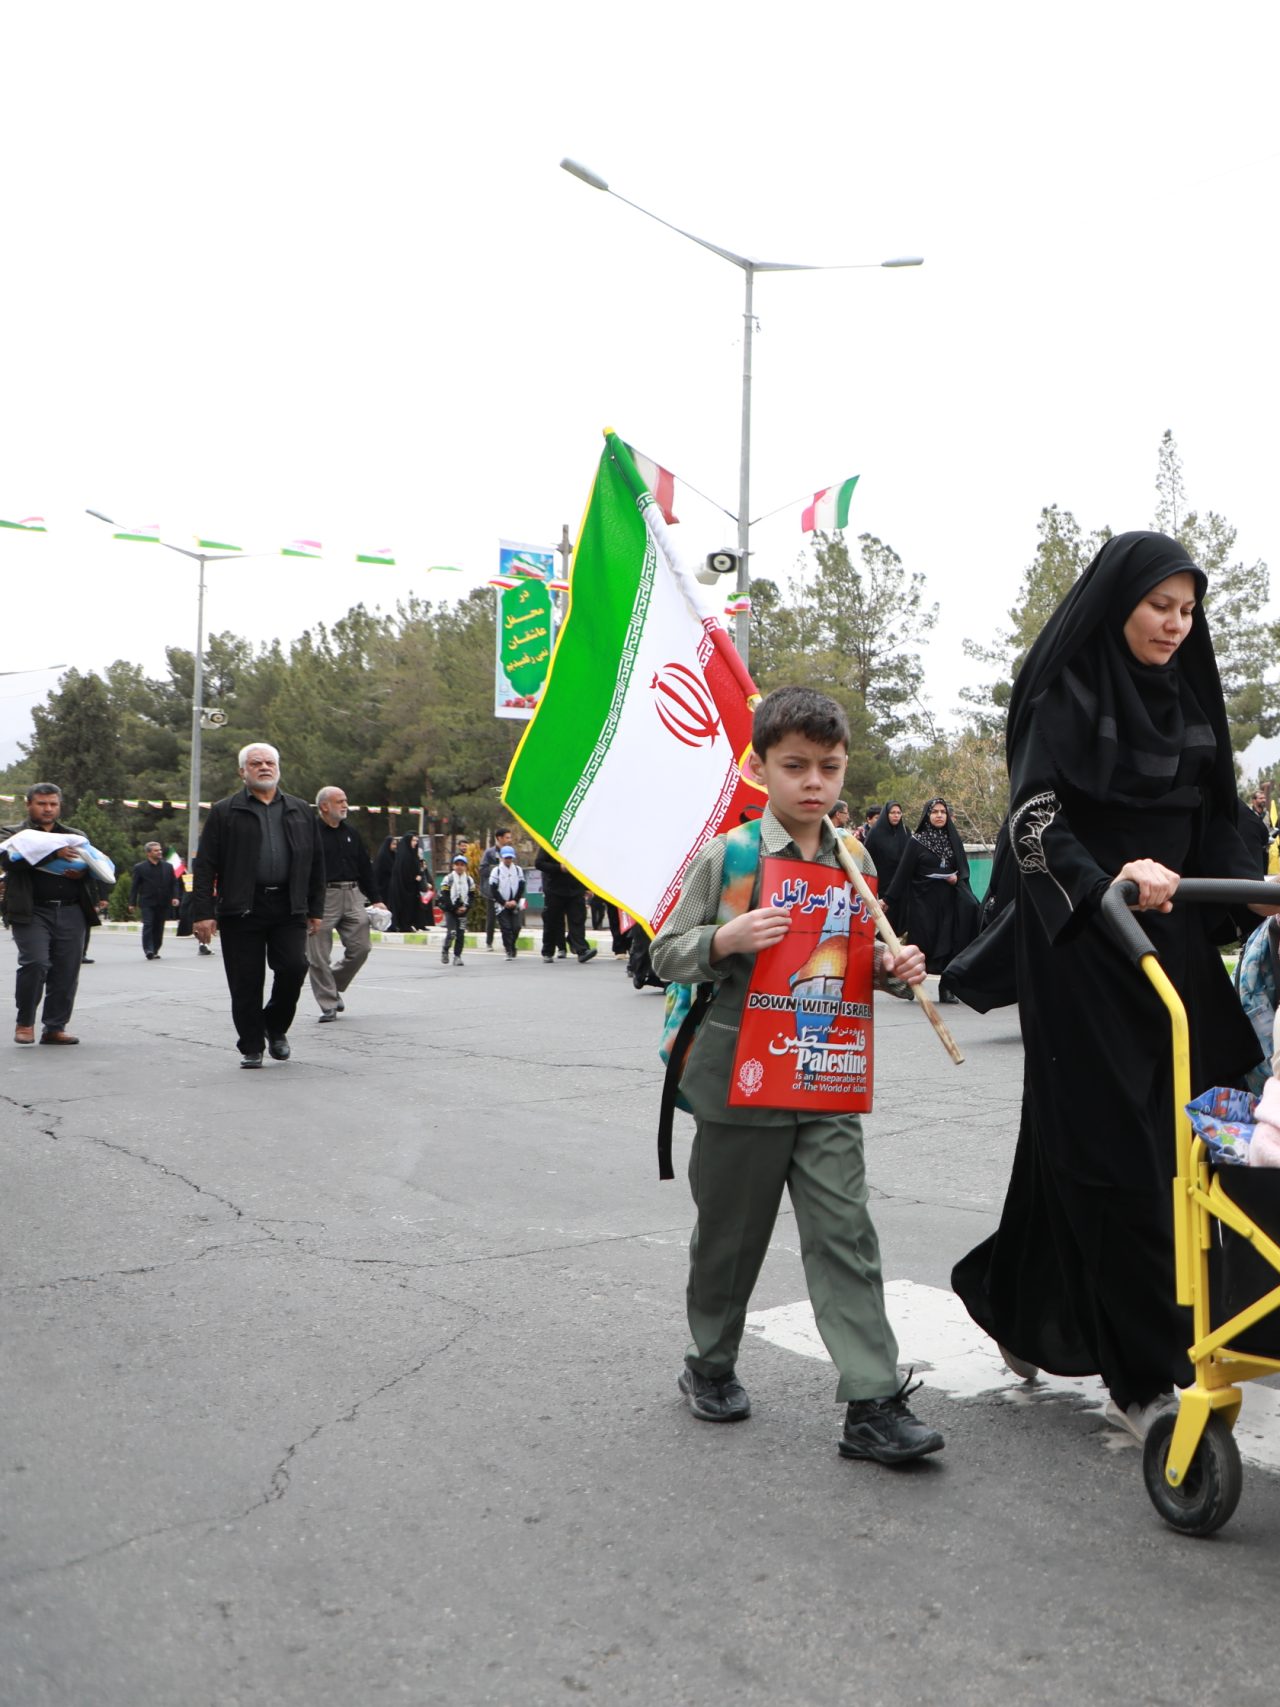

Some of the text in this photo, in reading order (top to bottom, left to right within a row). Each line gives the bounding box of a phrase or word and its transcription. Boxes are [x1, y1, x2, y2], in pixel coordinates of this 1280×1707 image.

[520, 590, 530, 603] در
[505, 608, 544, 629] محفل
[508, 628, 546, 650] عاشقان
[771, 878, 833, 914] اسرائیل
[833, 894, 848, 917] بر
[748, 993, 872, 1018] DOWN WITH ISRAEL
[768, 1025, 866, 1056] فلسطین
[796, 1047, 867, 1075] Palestine
[792, 1082, 801, 1090] of
[803, 1082, 817, 1091] The
[820, 1083, 842, 1092] World
[843, 1084, 852, 1092] of
[795, 1071, 803, 1080] Is
[803, 1073, 814, 1081] an
[815, 1072, 855, 1084] Inseparable
